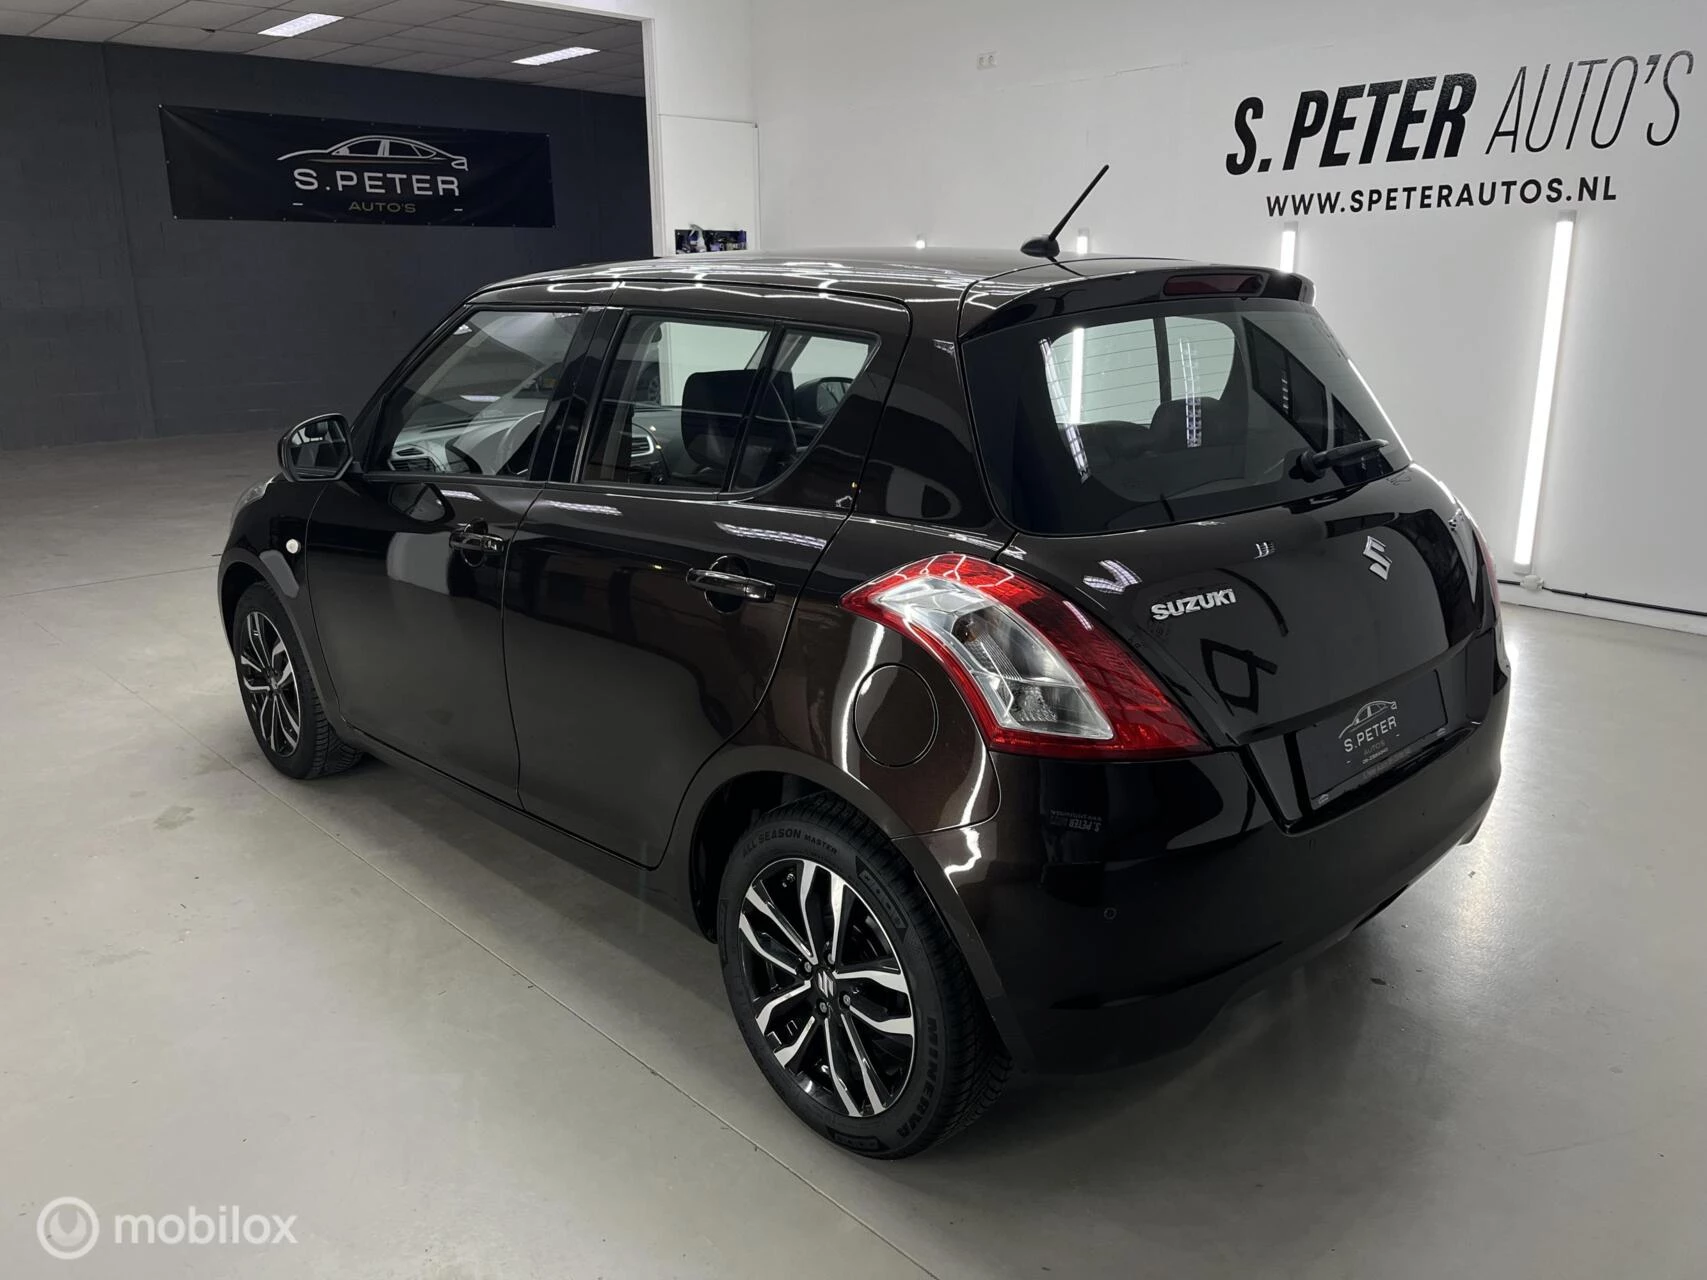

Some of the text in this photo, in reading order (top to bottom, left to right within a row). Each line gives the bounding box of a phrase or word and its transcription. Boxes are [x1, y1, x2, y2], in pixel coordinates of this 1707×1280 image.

[1484, 50, 1695, 155] AUTO'S
[293, 168, 460, 197] S.PETER
[1266, 175, 1618, 217] WWW.SPETERAUTOS.NL
[348, 201, 417, 214] AUTO'S
[1150, 588, 1237, 621] SUZUKI
[1343, 715, 1398, 753] S.PETER
[759, 828, 802, 844] SEASON
[804, 834, 838, 855] MASTER
